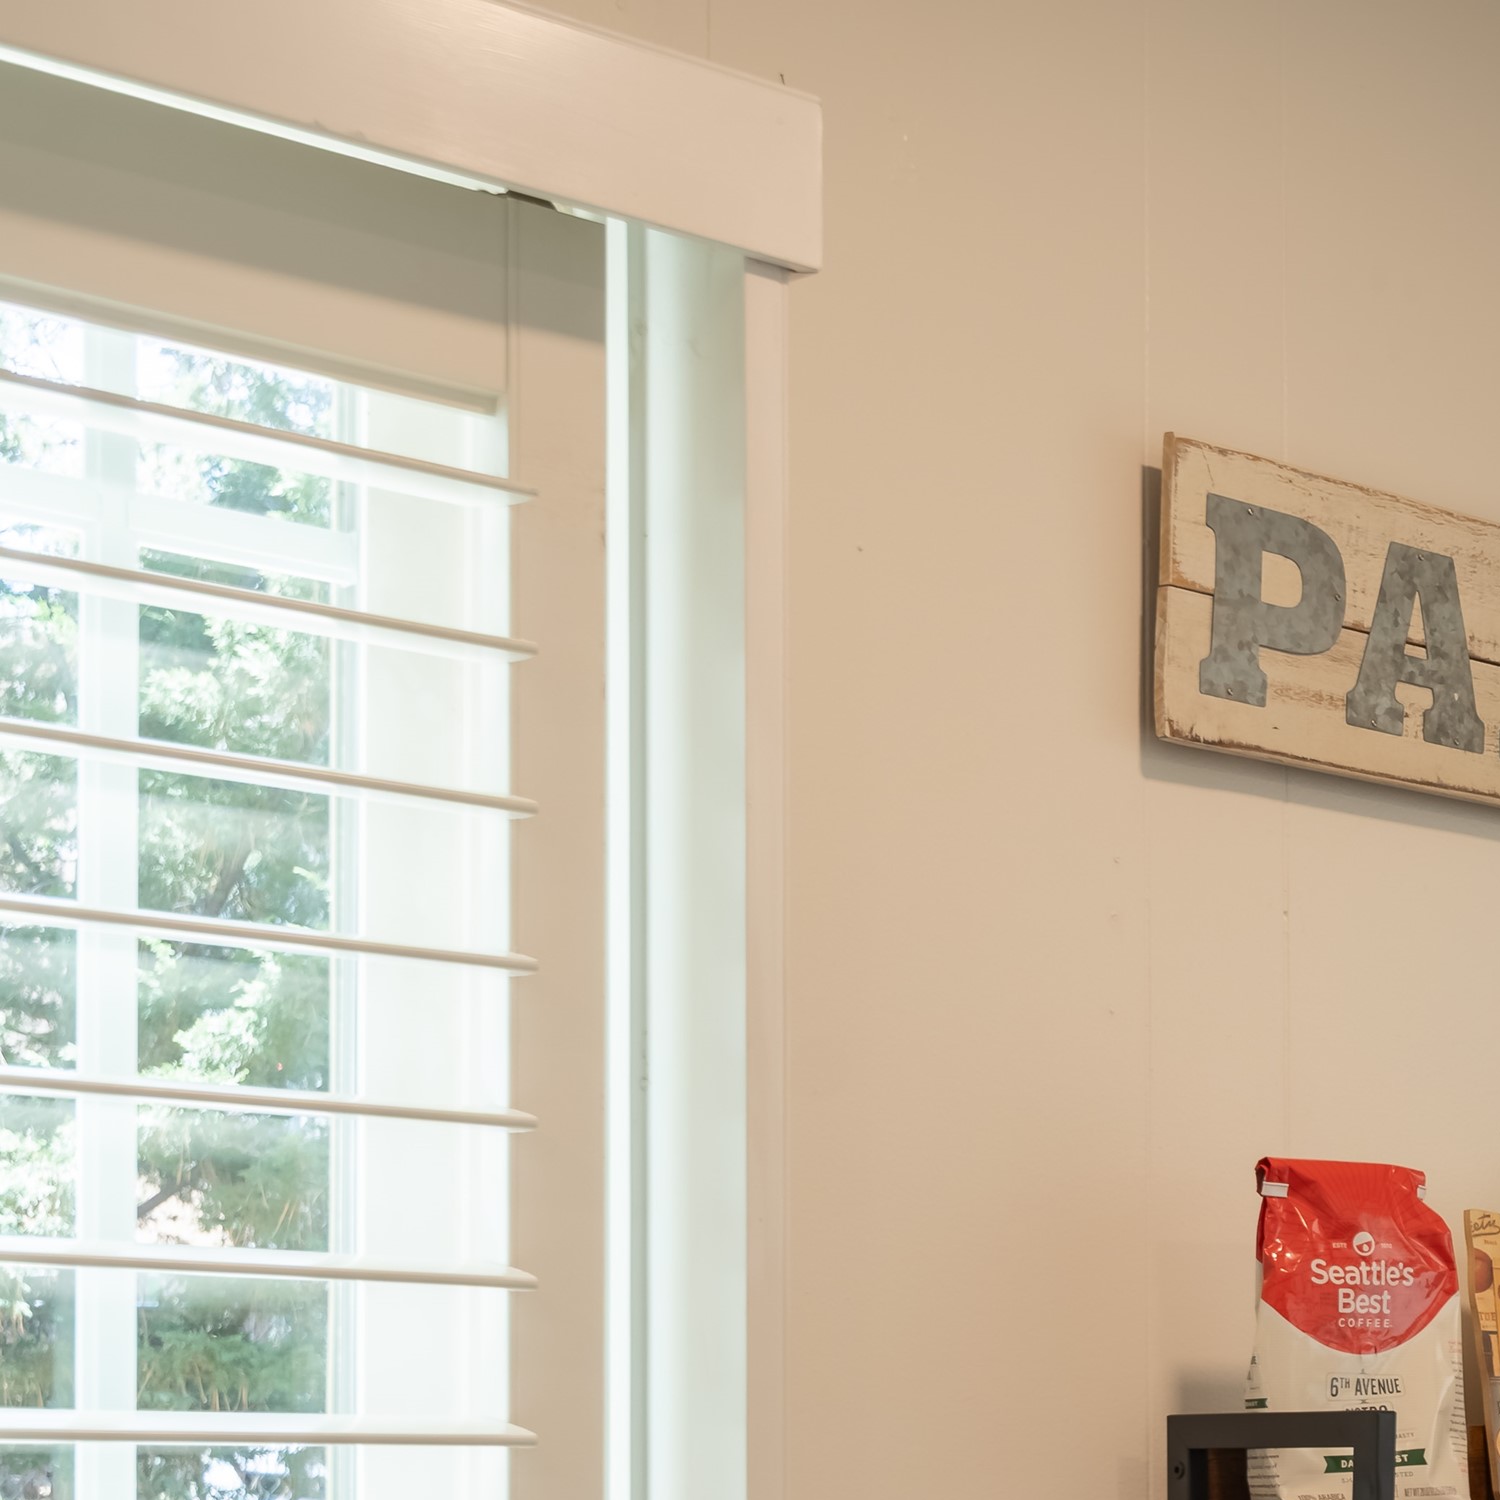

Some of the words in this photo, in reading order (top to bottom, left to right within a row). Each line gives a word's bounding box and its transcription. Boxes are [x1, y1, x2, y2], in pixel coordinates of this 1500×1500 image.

[1310, 1258, 1414, 1287] Seattle's
[1338, 1288, 1391, 1315] Best
[1338, 1318, 1391, 1328] COFFEE
[1330, 1376, 1350, 1397] 6TH
[1354, 1377, 1402, 1397] AVENUE
[1318, 1493, 1346, 1500] ARABICA
